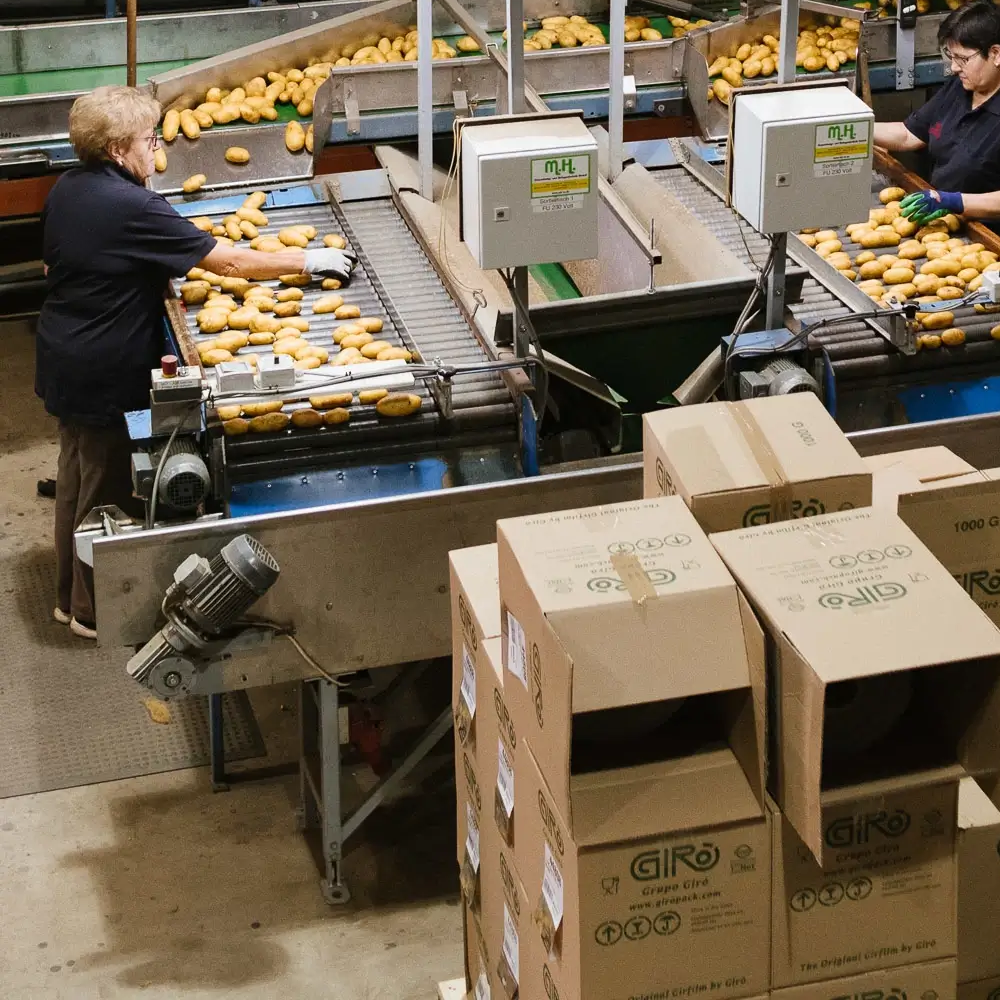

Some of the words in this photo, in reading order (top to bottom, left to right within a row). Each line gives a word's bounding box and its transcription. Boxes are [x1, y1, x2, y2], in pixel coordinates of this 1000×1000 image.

[954, 518, 985, 533] 1000
[988, 516, 1000, 527] G
[641, 883, 680, 897] Grupo
[628, 890, 722, 912] www.giropack.com
[800, 963, 818, 973] The
[819, 951, 861, 970] Original
[901, 943, 913, 955] by
[671, 984, 708, 997] Girfilm
[709, 980, 722, 991] by
